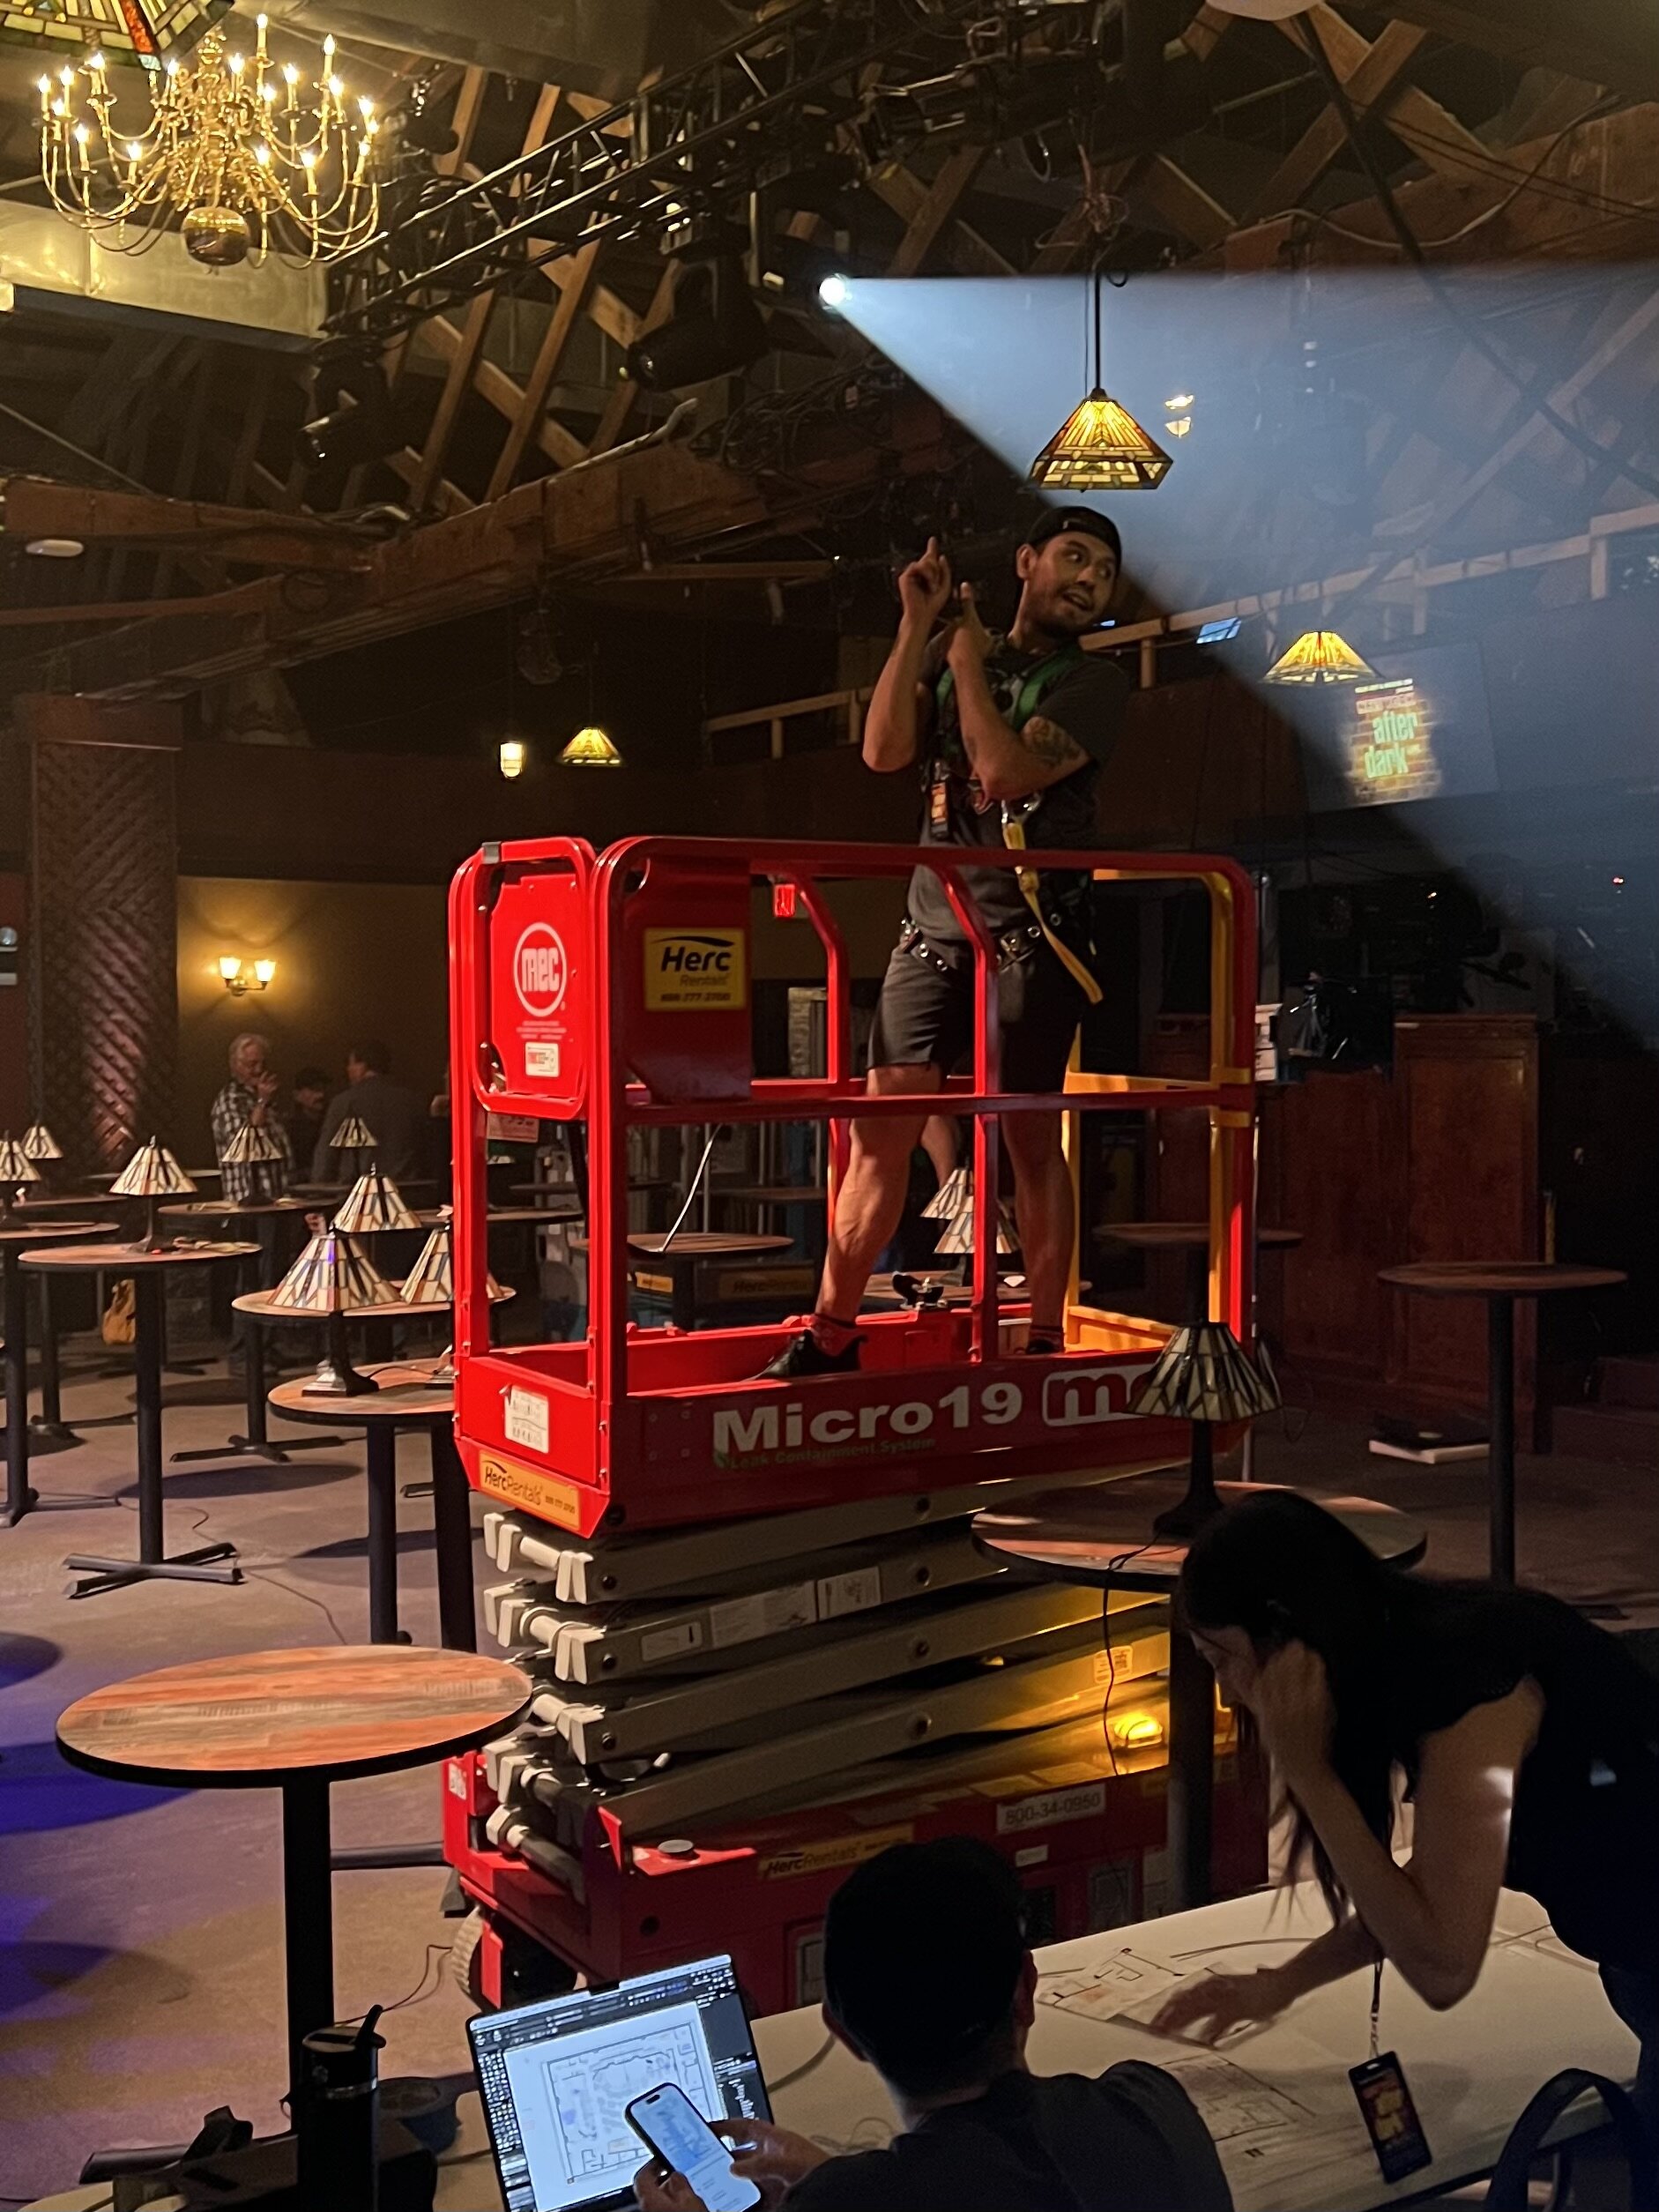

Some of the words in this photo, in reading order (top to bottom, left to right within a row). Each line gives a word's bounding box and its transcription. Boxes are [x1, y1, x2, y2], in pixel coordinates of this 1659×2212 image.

[1373, 711, 1417, 744] after
[1364, 742, 1410, 778] dark
[661, 947, 732, 972] Herc
[713, 1382, 1023, 1455] Micro19
